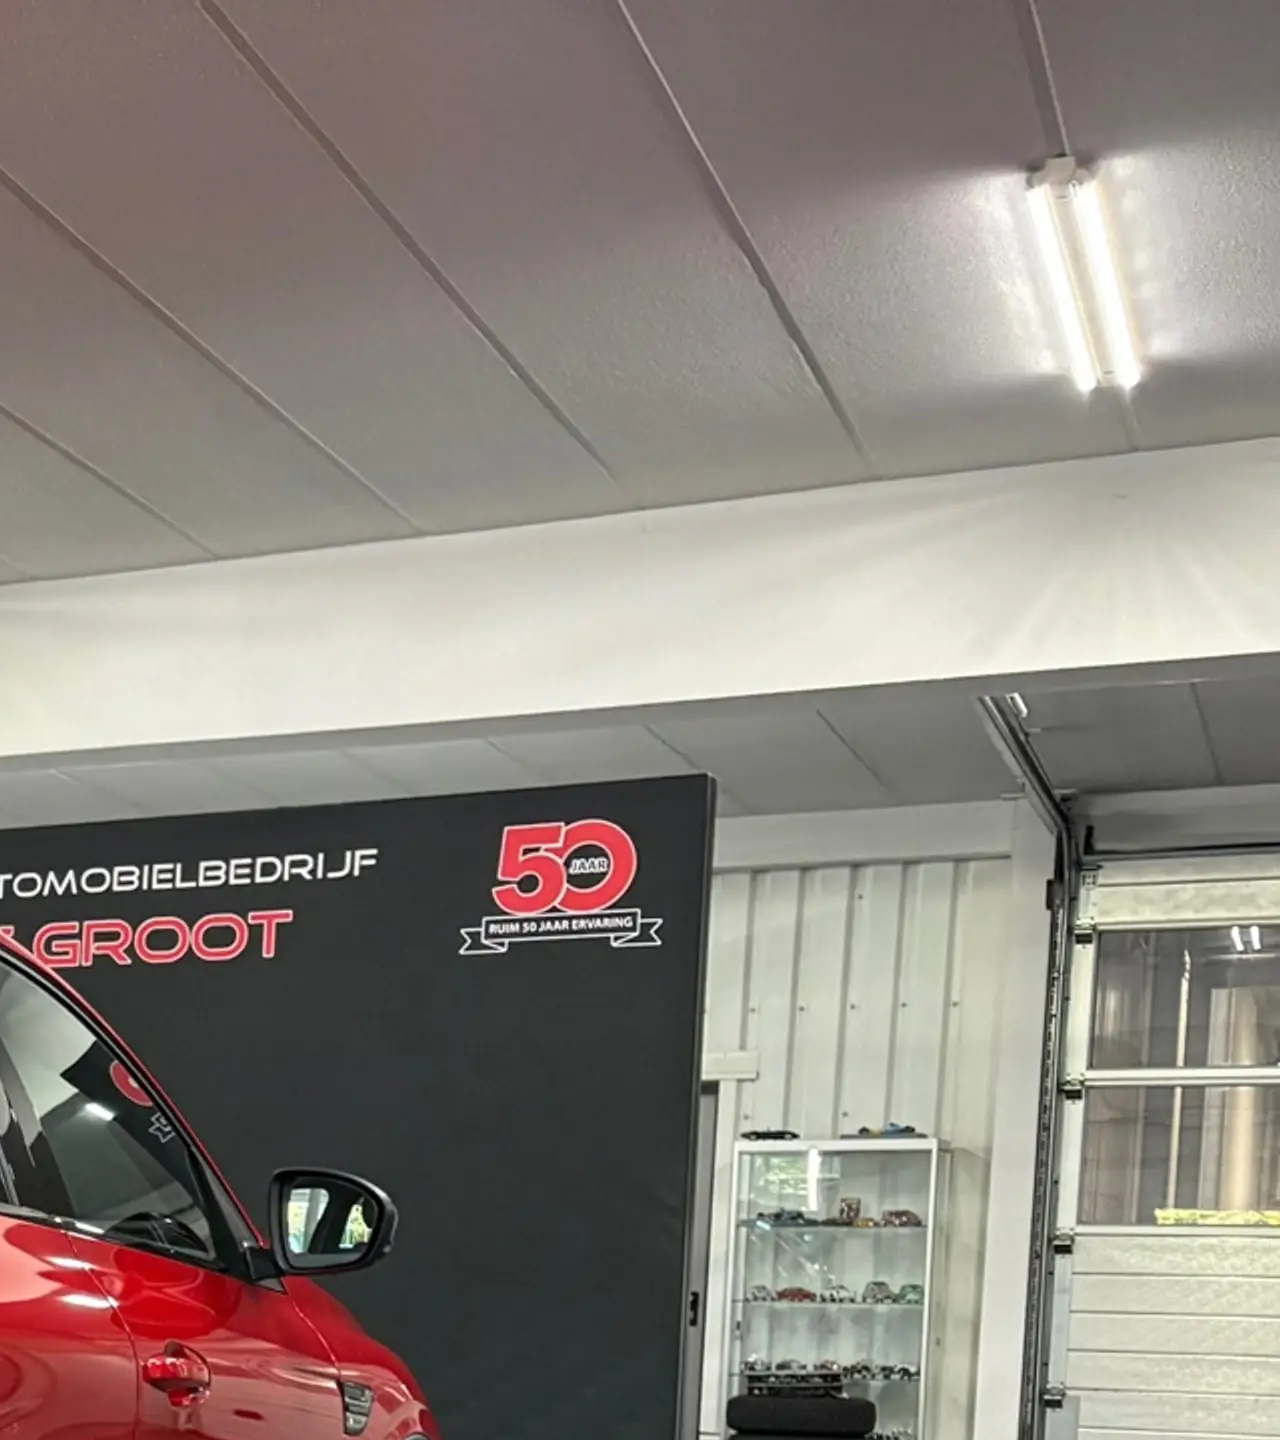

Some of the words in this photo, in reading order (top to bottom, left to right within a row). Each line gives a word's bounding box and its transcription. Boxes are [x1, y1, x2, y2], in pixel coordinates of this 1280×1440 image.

[492, 818, 638, 917] 50
[569, 857, 610, 875] JAAR
[32, 910, 294, 969] GROOT
[488, 922, 520, 935] RUIM
[522, 921, 537, 933] 50
[539, 918, 569, 932] JAAR
[572, 916, 633, 931] ERVARING
